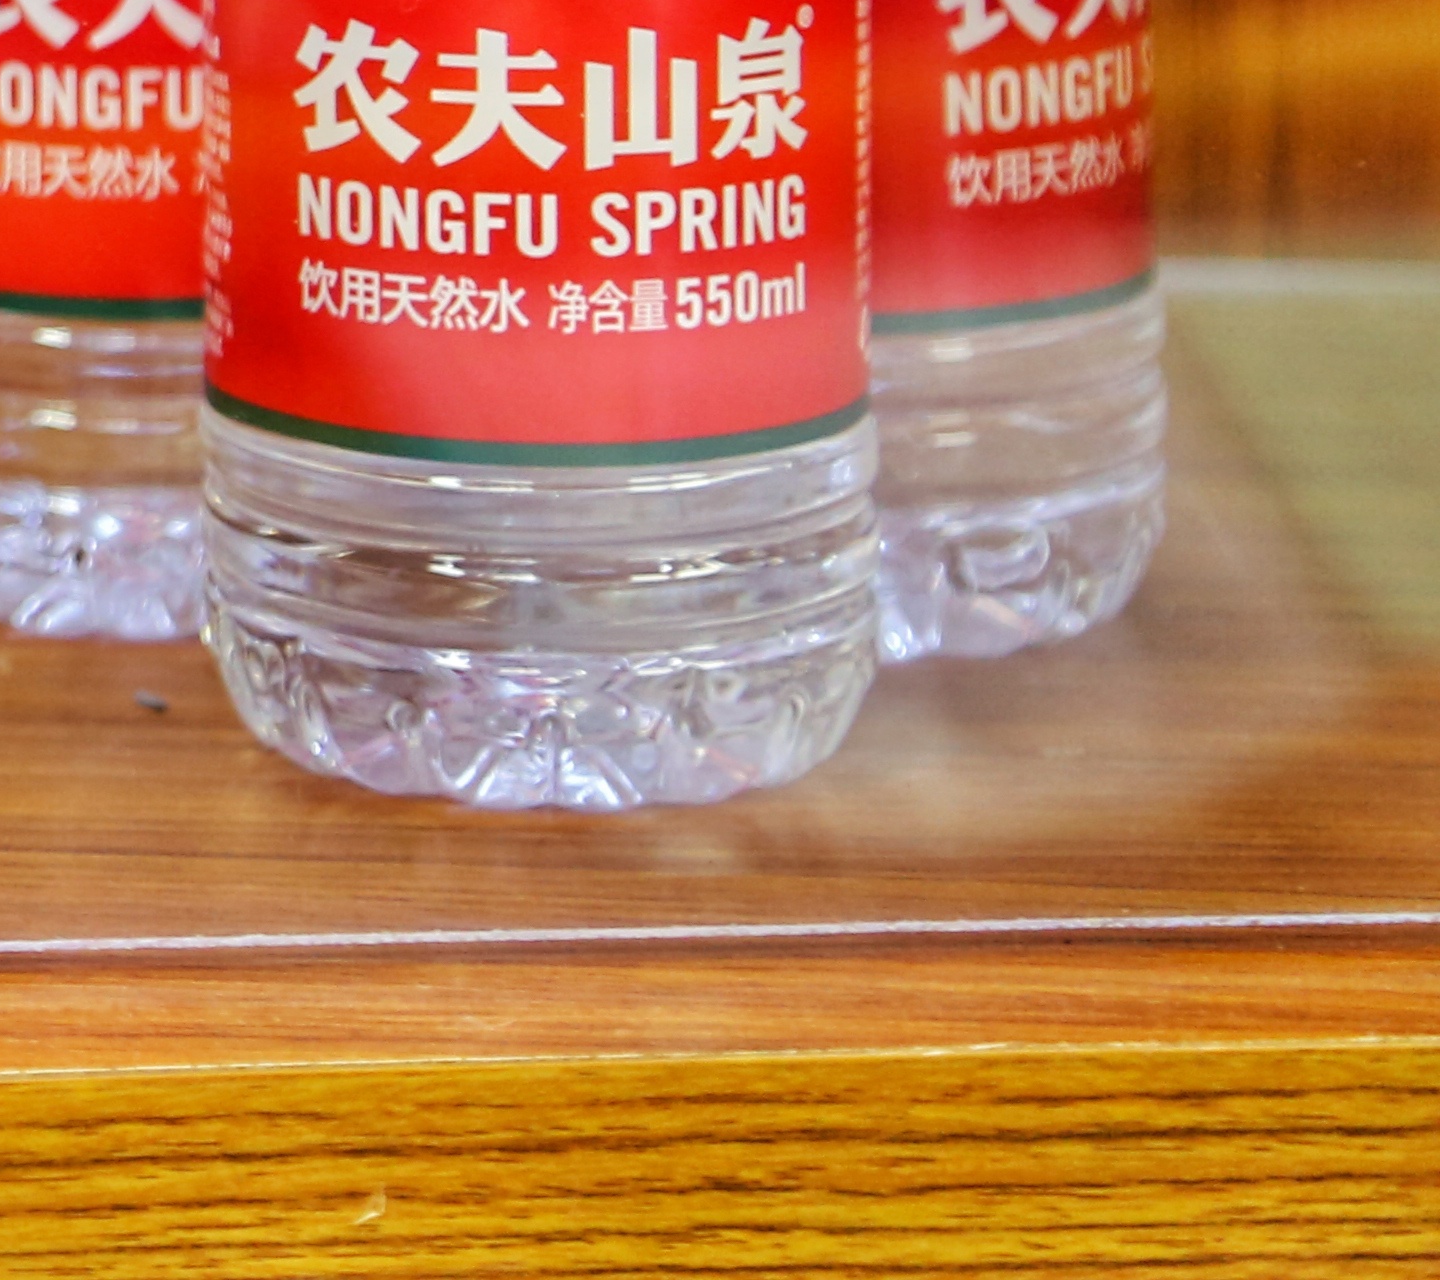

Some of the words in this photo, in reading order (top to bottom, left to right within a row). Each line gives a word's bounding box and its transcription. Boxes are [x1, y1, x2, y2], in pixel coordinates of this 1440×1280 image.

[293, 18, 809, 171] 农夫山泉
[943, 42, 1133, 137] NONGFU
[296, 172, 559, 259] NONGFU
[590, 174, 806, 258] SPRING
[297, 257, 530, 334] 饮用天然水
